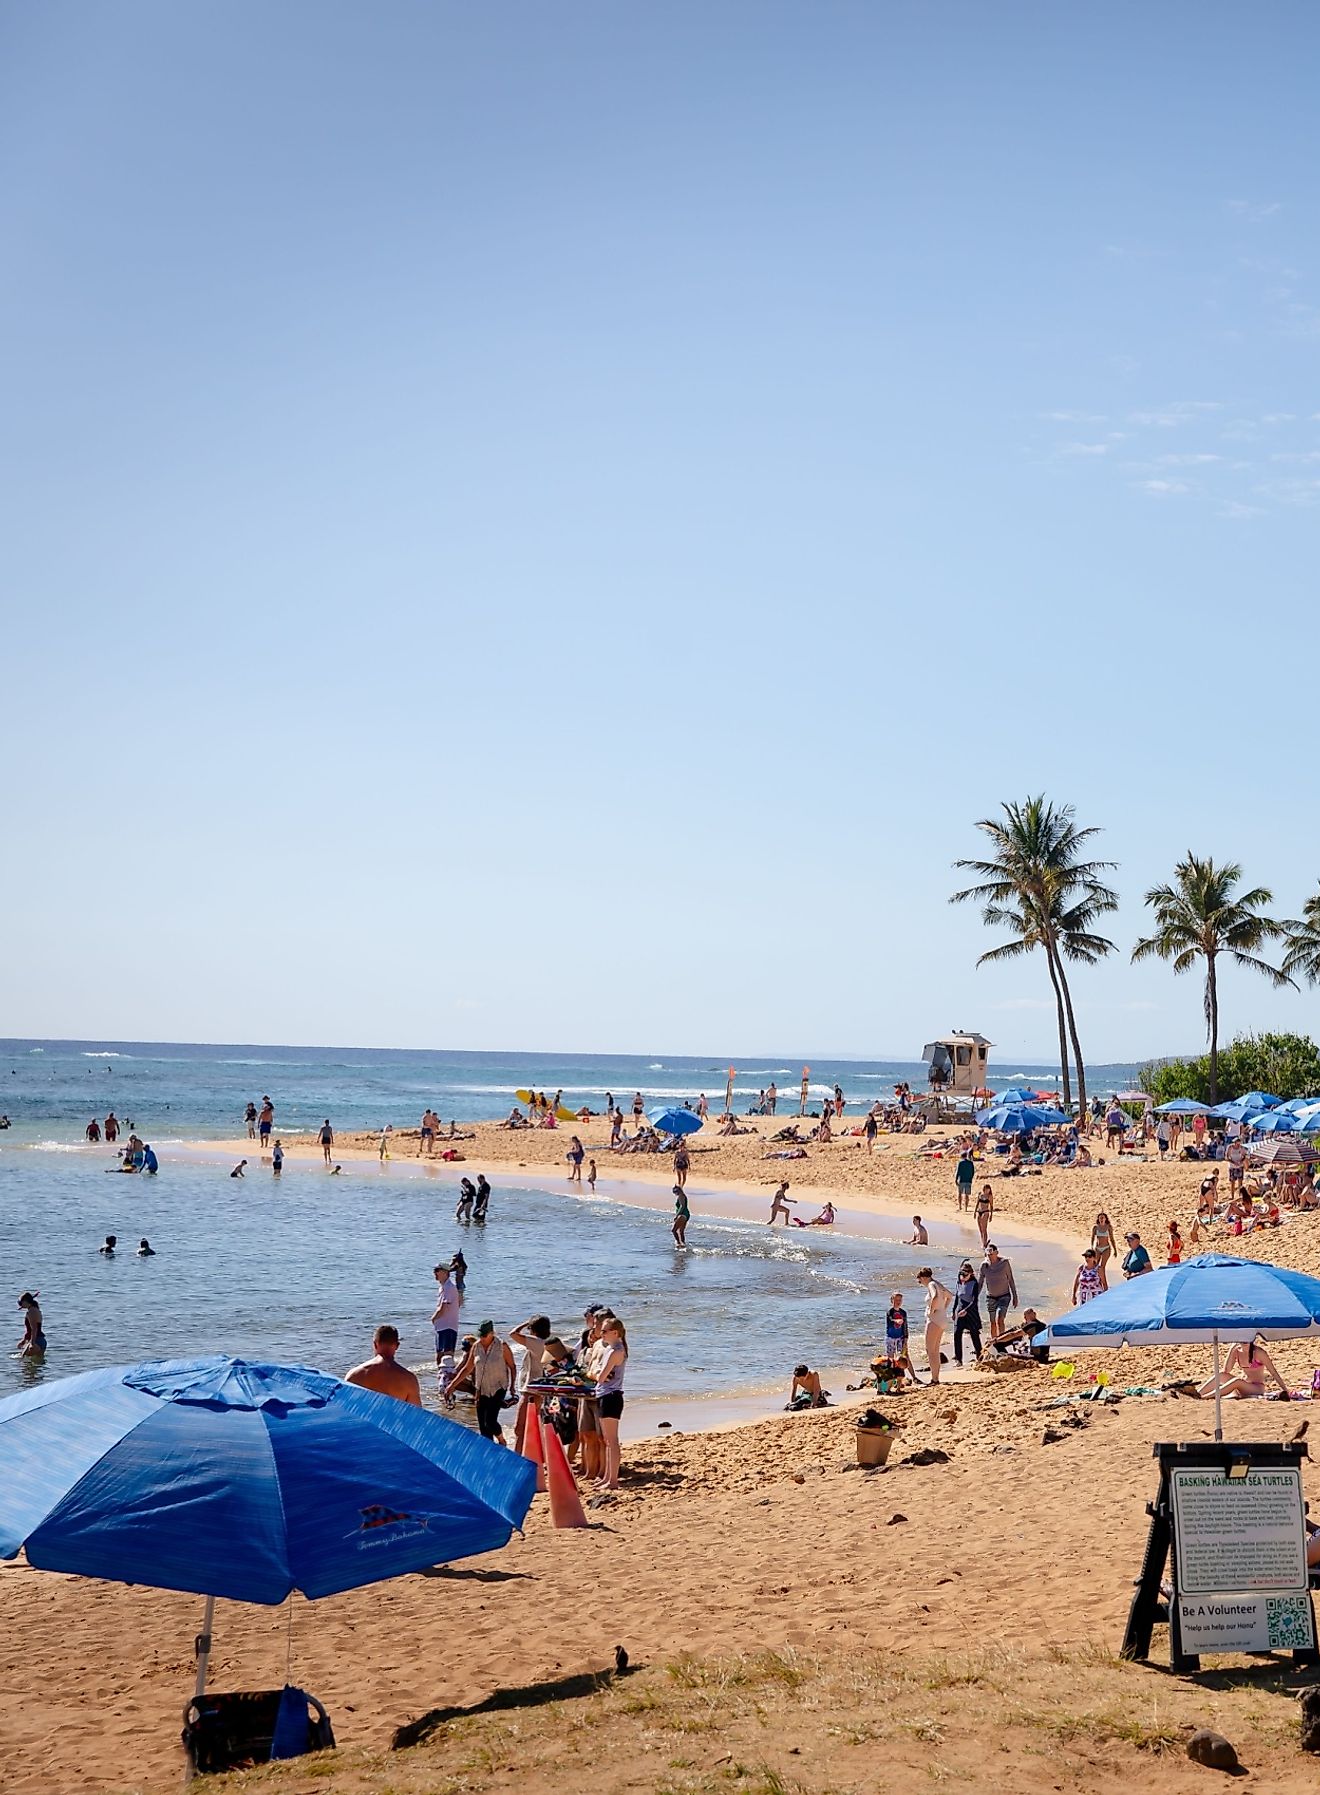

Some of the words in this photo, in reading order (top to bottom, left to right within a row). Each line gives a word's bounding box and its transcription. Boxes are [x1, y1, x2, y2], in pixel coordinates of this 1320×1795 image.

[1179, 1476, 1211, 1487] BASKING
[1247, 1476, 1262, 1486] SEA
[1262, 1475, 1293, 1486] TURTLES
[1182, 1606, 1196, 1617] Be
[1197, 1605, 1206, 1616] A
[1207, 1604, 1257, 1616] Volunteer
[1211, 1623, 1225, 1632] help
